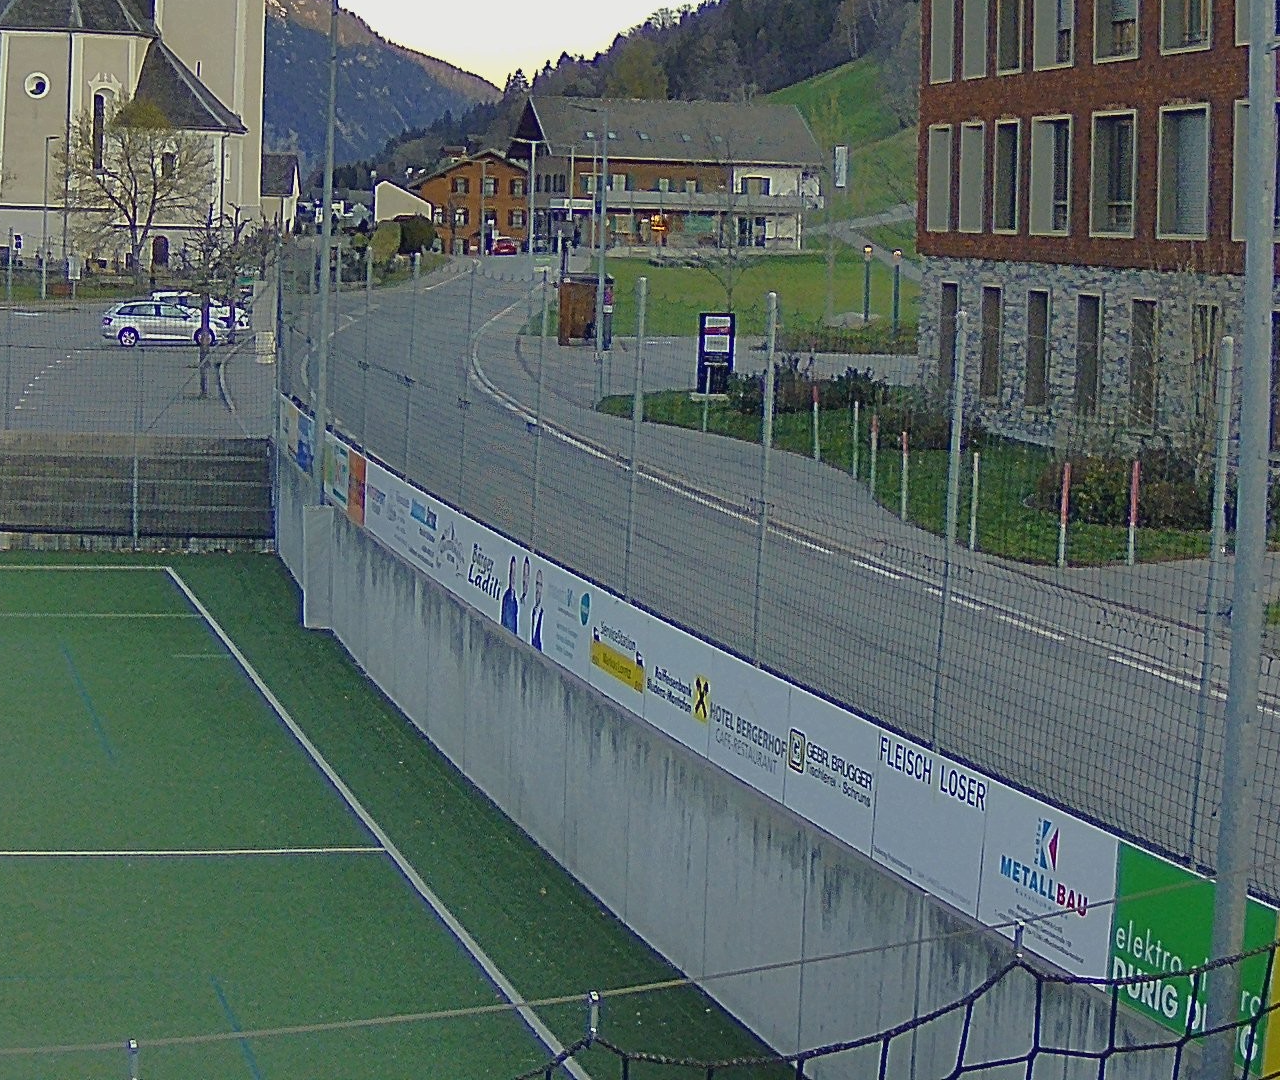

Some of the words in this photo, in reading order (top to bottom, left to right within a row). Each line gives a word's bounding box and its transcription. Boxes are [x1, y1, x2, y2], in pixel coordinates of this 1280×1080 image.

[709, 701, 735, 731] HOTEL
[736, 715, 787, 759] BERGERHOF
[880, 736, 933, 785] FLEISCH
[939, 765, 986, 812] LOSER
[1000, 854, 1089, 917] METALLBAU
[1115, 920, 1183, 971] elektro
